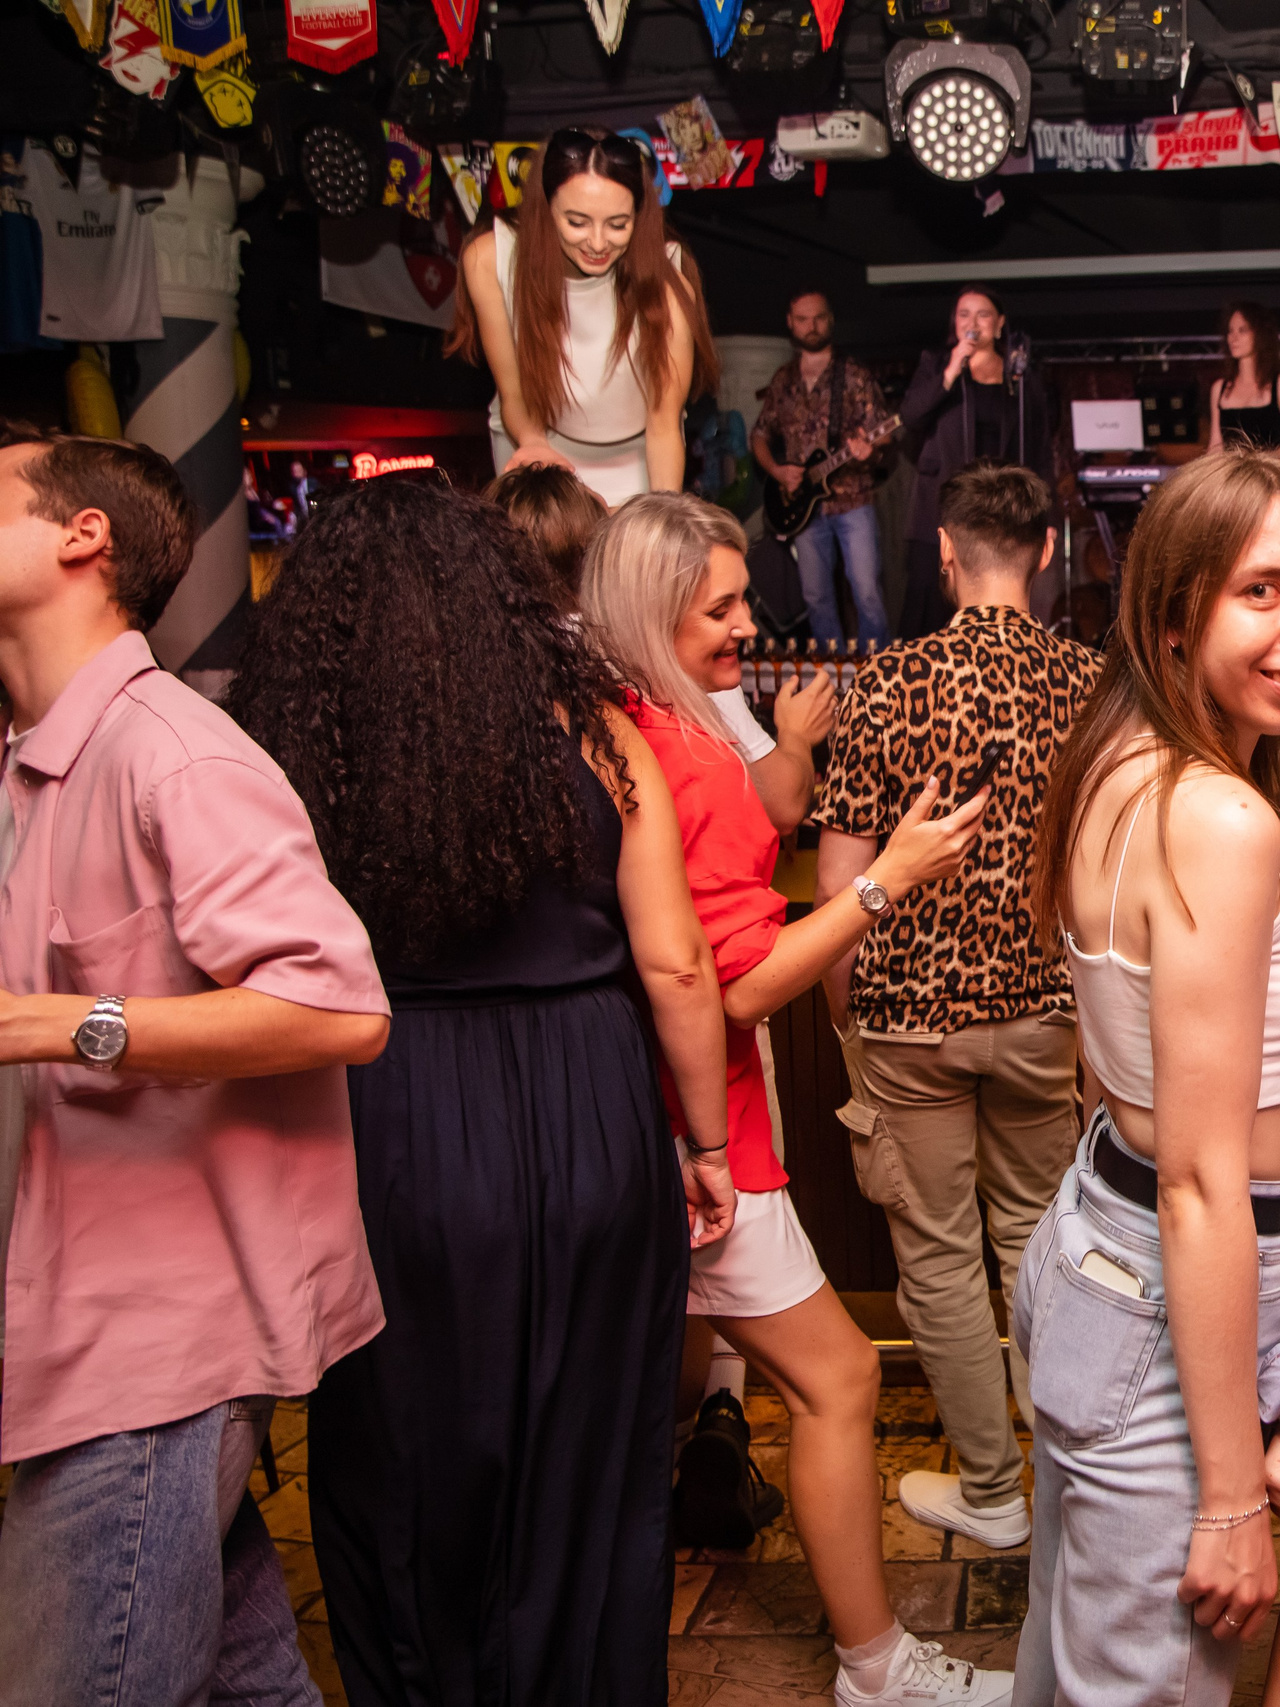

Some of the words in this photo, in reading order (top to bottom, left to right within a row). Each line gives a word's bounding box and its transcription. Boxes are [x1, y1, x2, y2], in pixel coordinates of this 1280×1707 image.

[301, 5, 362, 22] LIVERPOOL
[302, 19, 341, 31] FOOTBALL
[343, 16, 363, 28] CLUB
[1157, 133, 1239, 156] PRAHA
[57, 220, 116, 238] Emirate
